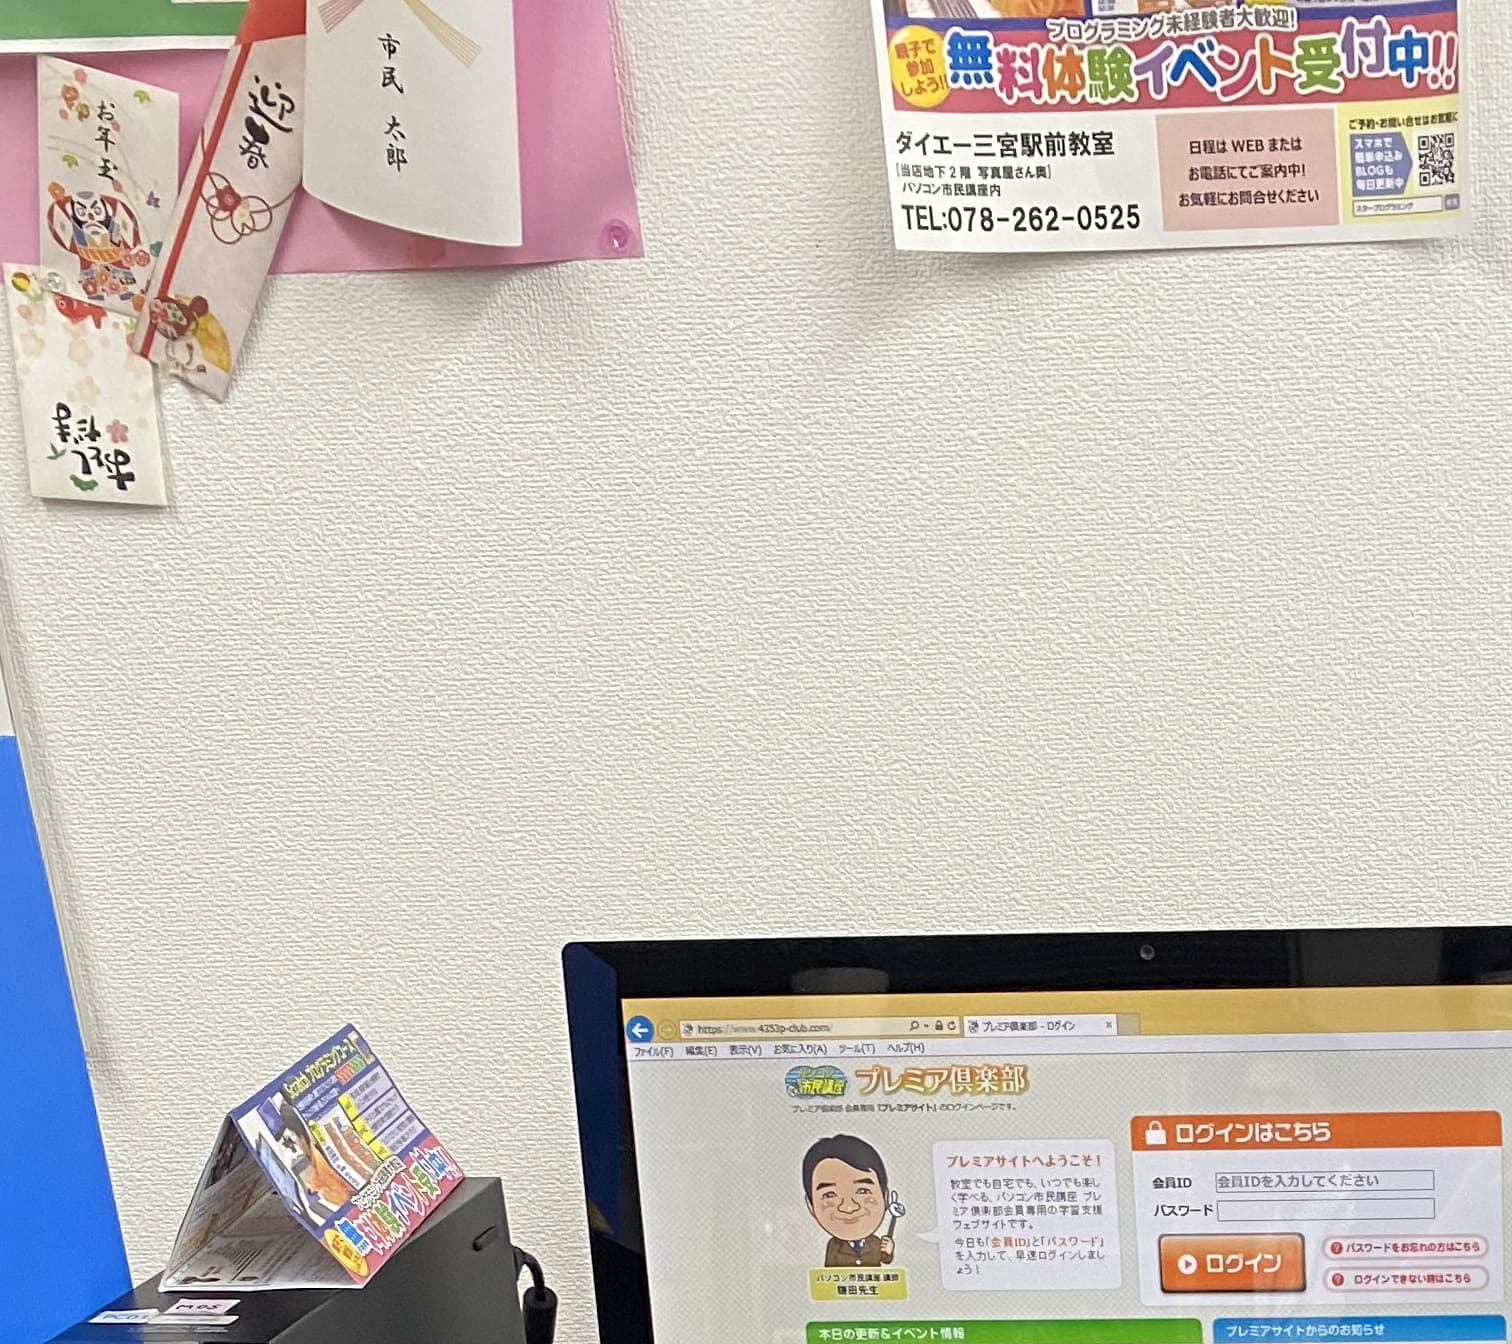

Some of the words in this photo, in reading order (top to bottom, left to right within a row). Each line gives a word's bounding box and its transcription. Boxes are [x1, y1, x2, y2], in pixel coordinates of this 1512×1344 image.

[377, 32, 404, 94] 市民
[384, 115, 409, 173] 太郎
[896, 131, 1115, 158] ダイエー三宮駅前教室
[1232, 139, 1264, 153] WEB
[1269, 137, 1303, 152] または
[1355, 137, 1393, 149] スマホで
[1355, 165, 1394, 177] BLOGも
[903, 182, 1001, 197] パソコン市民講座内
[1178, 190, 1320, 208] お気軽にお問合せください
[901, 204, 1141, 232] TEL:078-262-0525
[887, 1042, 925, 1054] ヘルプ(H)
[855, 1063, 1028, 1095] プレミア倶楽部
[1175, 1121, 1332, 1143] ログインはこちら
[947, 1154, 1102, 1168] プレミアサイトへようこそ！
[1152, 1176, 1192, 1189] 会員ID
[1217, 1173, 1380, 1189] 会員IDを入力してください
[1153, 1203, 1214, 1218] パスワード
[953, 1219, 1034, 1230] ウェブサイトです。
[1346, 1241, 1481, 1254] パスワードをお忘れの方はこちら
[1206, 1253, 1283, 1274] ログイン
[818, 1326, 966, 1341] 本日の更新&イベント情報
[1226, 1323, 1386, 1338] プレミアサイトからのお知らせ
